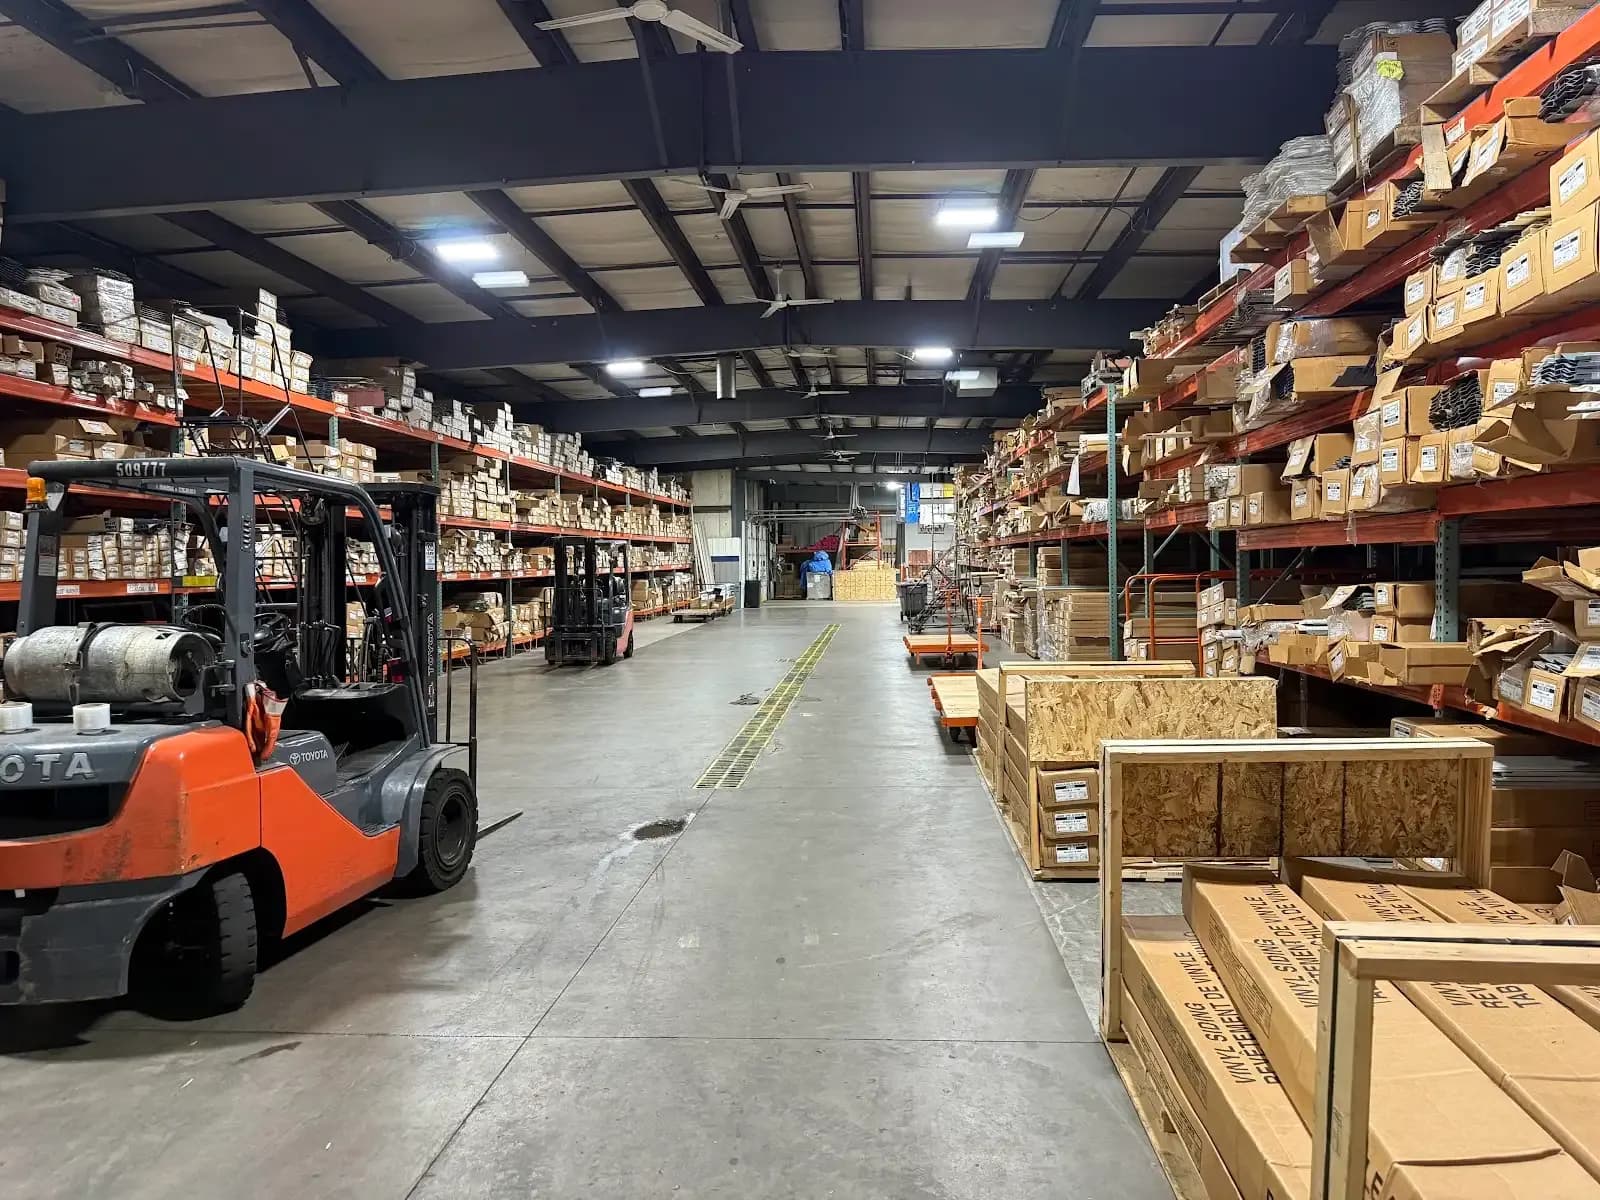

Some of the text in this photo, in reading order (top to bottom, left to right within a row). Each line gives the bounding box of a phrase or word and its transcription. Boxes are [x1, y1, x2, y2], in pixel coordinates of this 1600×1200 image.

[116, 462, 166, 477] 509777
[301, 750, 329, 762] TOYOTA
[1244, 896, 1283, 924] VINYLE
[1275, 903, 1302, 915] DE
[1390, 903, 1419, 914] DE
[1268, 925, 1296, 937] DE
[1174, 951, 1212, 984] VINYLE
[1254, 939, 1298, 973] SIDING
[1198, 985, 1225, 1000] DE
[1461, 985, 1509, 1008] REV
[1496, 985, 1541, 1008] TAB
[1184, 1002, 1228, 1042] SIDING
[1214, 1046, 1257, 1084] VINYL
